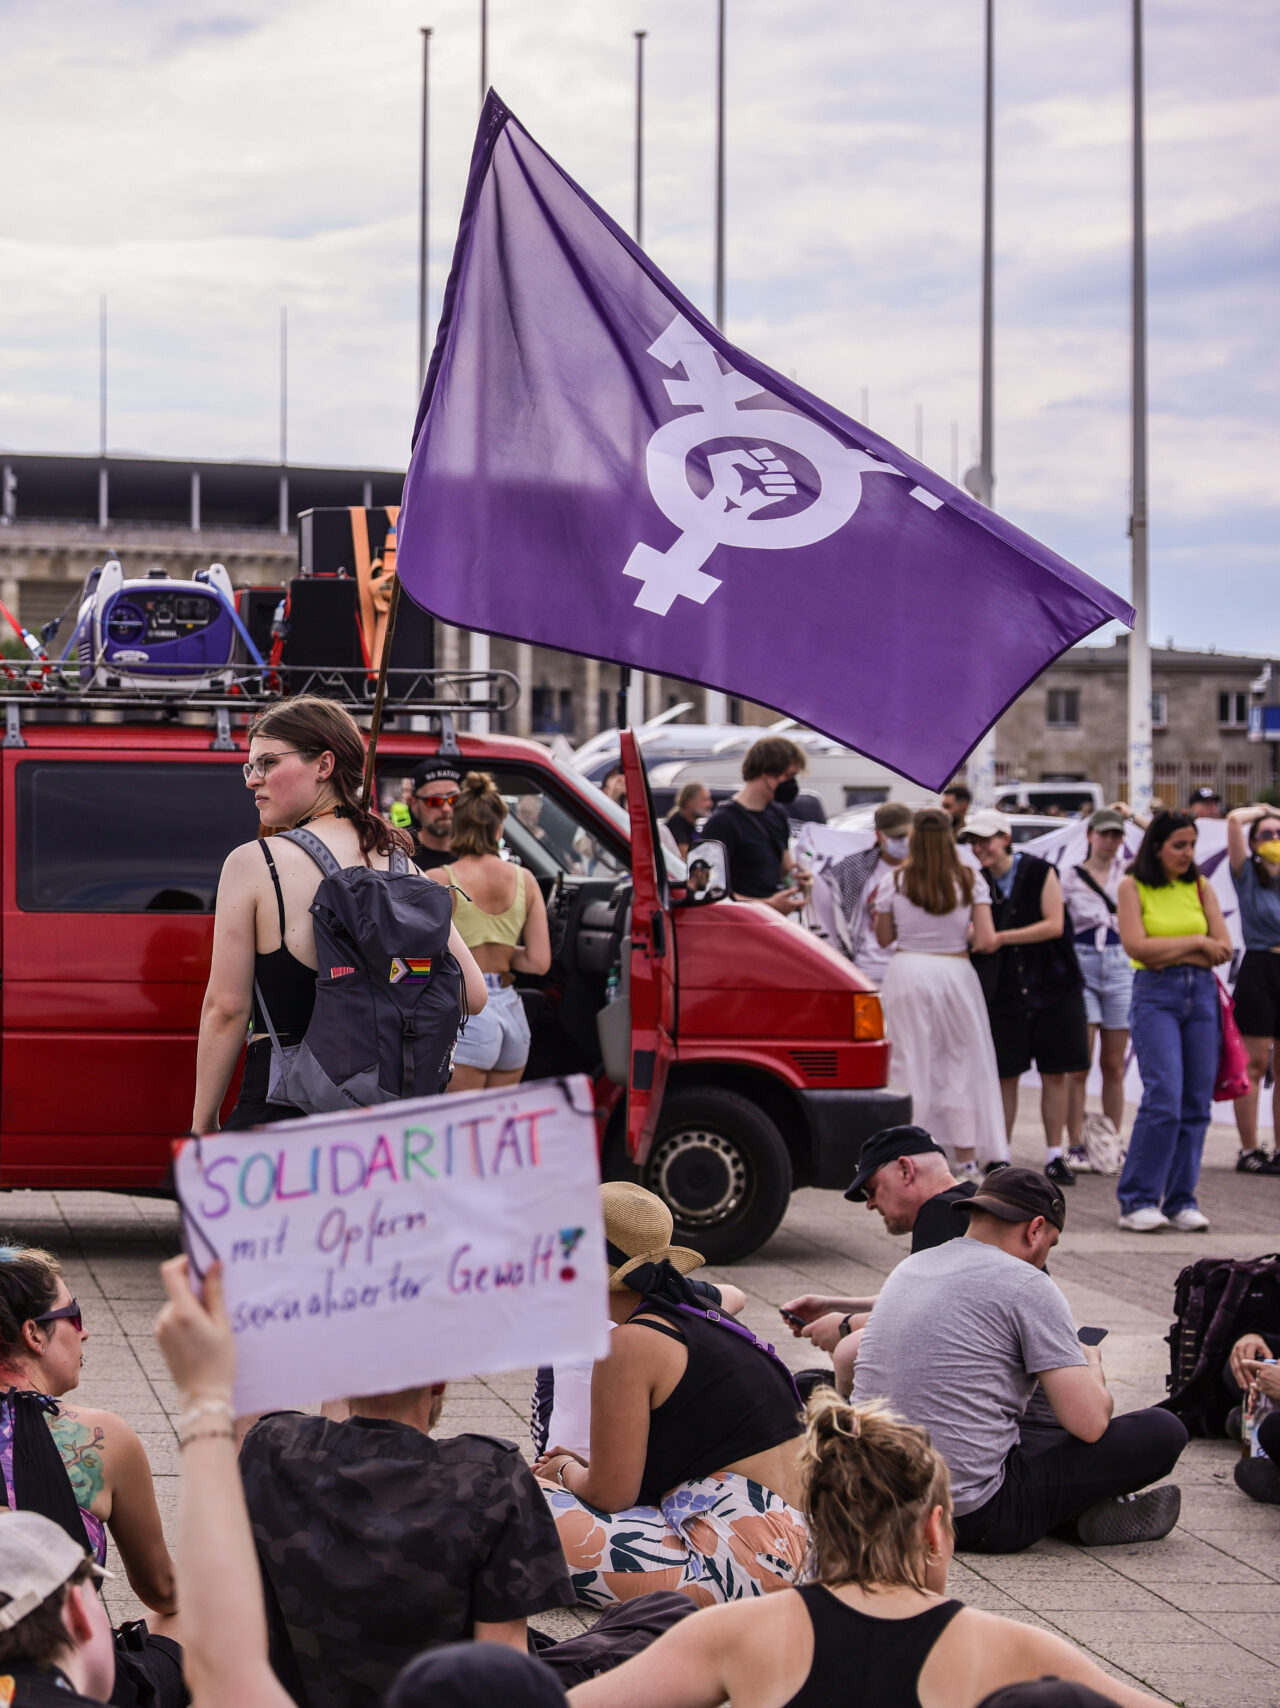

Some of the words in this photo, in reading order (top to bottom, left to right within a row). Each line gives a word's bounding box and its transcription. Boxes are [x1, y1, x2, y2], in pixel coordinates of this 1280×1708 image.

[199, 1103, 558, 1219] SOLIDARITÄT
[232, 1215, 290, 1262] mit
[317, 1199, 427, 1271] Opfern
[448, 1227, 586, 1295] Gewalt!
